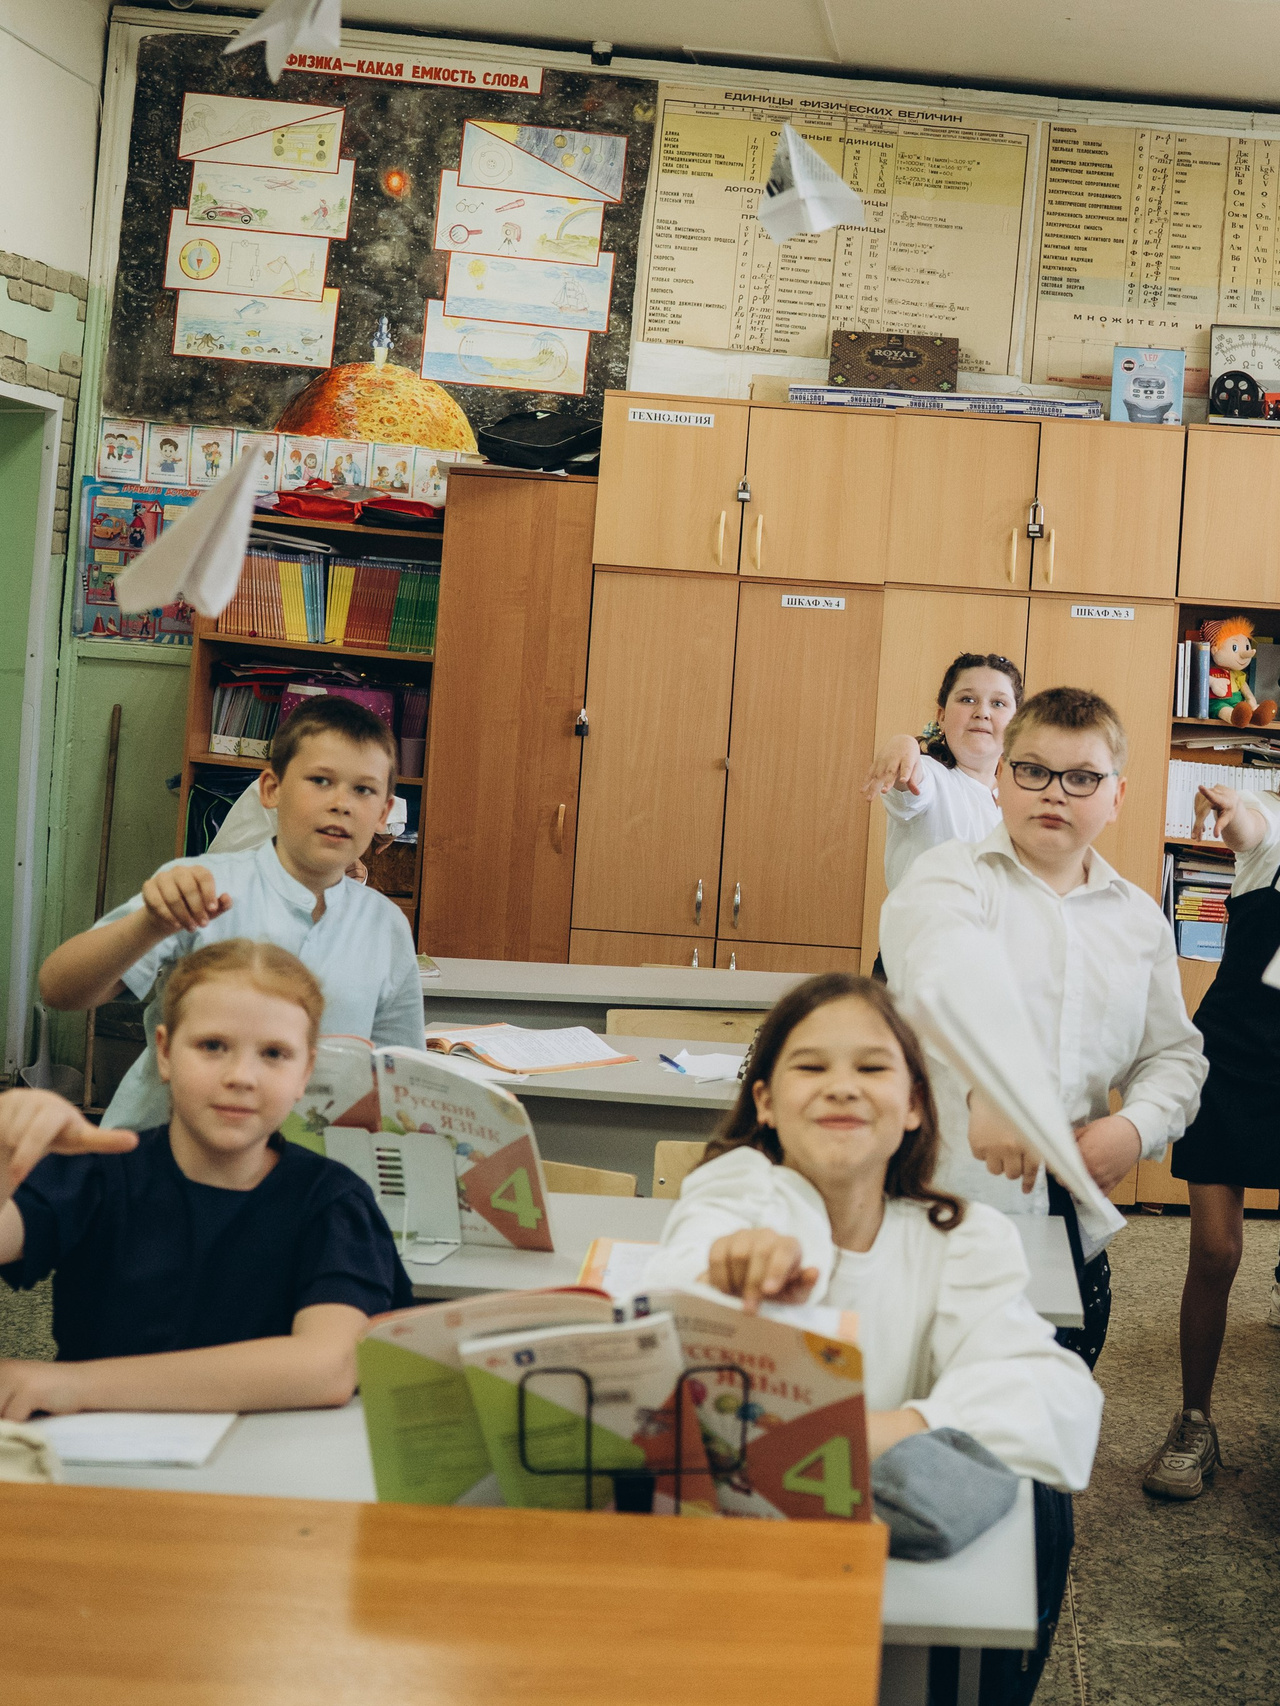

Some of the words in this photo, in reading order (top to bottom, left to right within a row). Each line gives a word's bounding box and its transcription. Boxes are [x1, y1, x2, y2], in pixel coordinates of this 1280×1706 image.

[412, 65, 476, 84] ЕМКОСТЬ
[483, 72, 529, 89] СЛОВА
[725, 92, 793, 106] ЕДИНИЦЫ
[800, 100, 892, 116] ФИЗИЧЕСКИХ
[898, 110, 963, 122] ВЕЛИЧИН
[838, 137, 894, 149] ЕДИНИЦЫ
[663, 156, 711, 165] ТЕРМОДИНАМИЧЕСКАЯ
[715, 160, 744, 168] ТЕМПЕРАТУРА
[1086, 169, 1114, 177] НАПРЯЖЕНИЕ
[1085, 180, 1120, 188] СОПРОТИВЛЕНИЕ
[1048, 189, 1084, 197] ЭЛЕКТРИЧЕСКАЯ
[1088, 191, 1122, 199] ПРОВОДИМОСТЬ
[1055, 200, 1087, 208] ЭЛЕКТРИЧЕСКОЕ
[1047, 211, 1083, 219] НАПРЯЖЕННОСТЬ
[675, 234, 712, 242] ПЕРИОДИЧЕСКОГО
[1042, 264, 1077, 272] ИНДУКТИВНОСТЬ
[1041, 290, 1073, 298] ОСВЕЩЕННОСТЬ
[1073, 314, 1179, 328] МНОЖИТЕЛИ
[874, 349, 916, 359] ROYAL
[1251, 349, 1256, 357] 0
[631, 410, 711, 425] ТЕХНОЛОГИЯ
[122, 485, 162, 495] ПРАВИЛА
[787, 598, 820, 607] ШКАФ
[833, 600, 840, 608] 4
[1076, 608, 1109, 617] ШКАФ
[1123, 611, 1129, 619] 3
[393, 1085, 476, 1120] Русский
[491, 1166, 543, 1230] 4
[783, 1436, 862, 1518] 4
